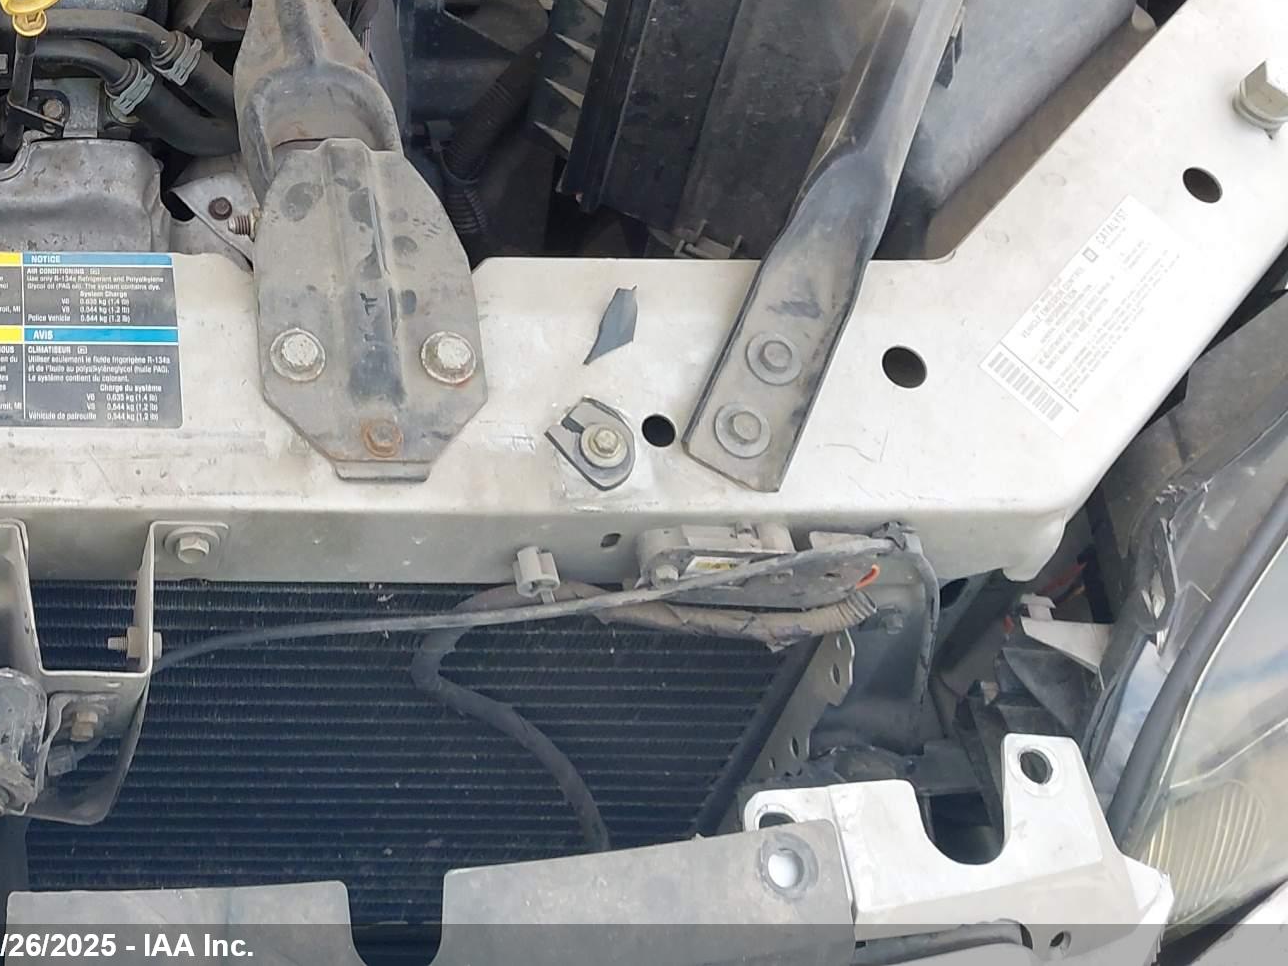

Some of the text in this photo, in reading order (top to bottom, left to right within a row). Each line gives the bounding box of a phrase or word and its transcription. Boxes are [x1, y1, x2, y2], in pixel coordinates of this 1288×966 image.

[1096, 208, 1129, 244] CATALYST
[31, 255, 60, 263] NOTICE
[33, 330, 53, 340] AVIS
